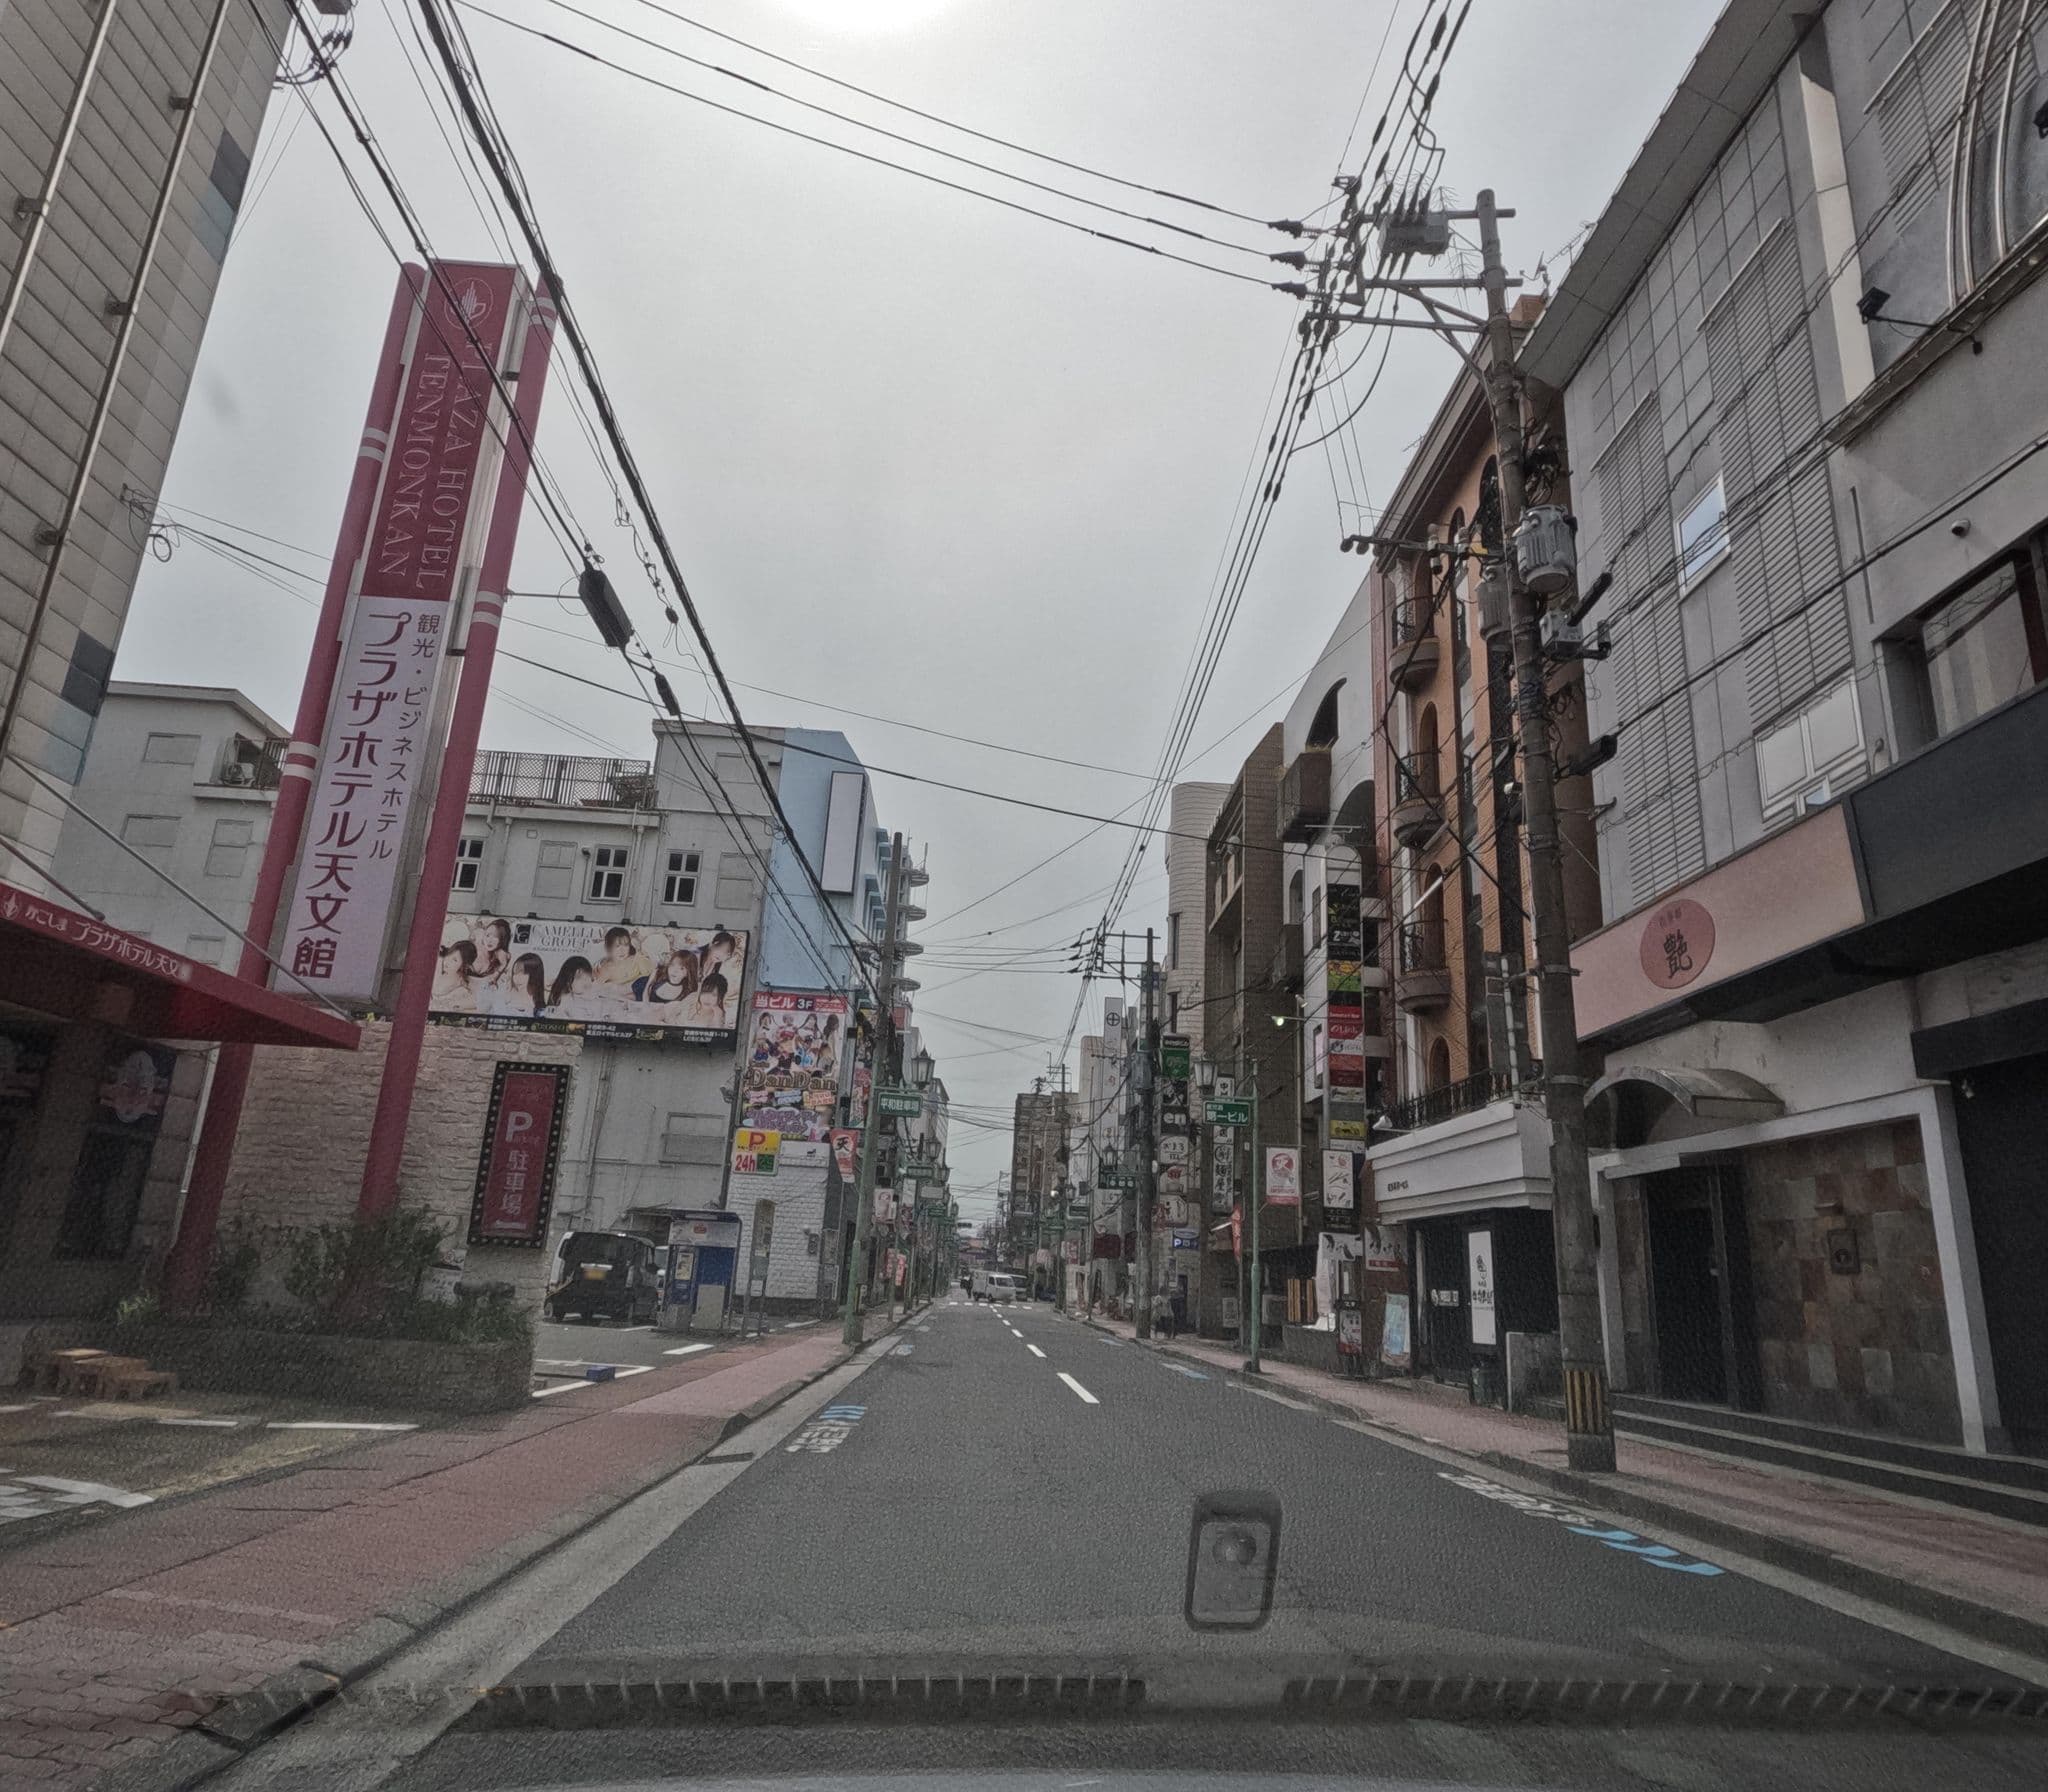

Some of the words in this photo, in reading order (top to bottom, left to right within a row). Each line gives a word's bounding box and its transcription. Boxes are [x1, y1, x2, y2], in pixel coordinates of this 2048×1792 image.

[443, 340, 492, 454] PLAZA
[379, 352, 450, 576] TENMONKAN
[416, 467, 467, 589] HOTEL
[369, 613, 441, 860] 観光・ビジネスホテル
[292, 611, 412, 979] プラザホテル天文館
[72, 920, 192, 982] プラザホテル天文
[541, 936, 590, 948] GROUP
[755, 994, 795, 1009] 当ビル
[797, 998, 814, 1009] 3F
[750, 1067, 837, 1091] DanDan
[1207, 1111, 1248, 1122] 第一ビル
[736, 1154, 755, 1172] 24h
[749, 1132, 765, 1151] P
[836, 1136, 850, 1152] 天
[500, 1150, 530, 1215] 駐車場
